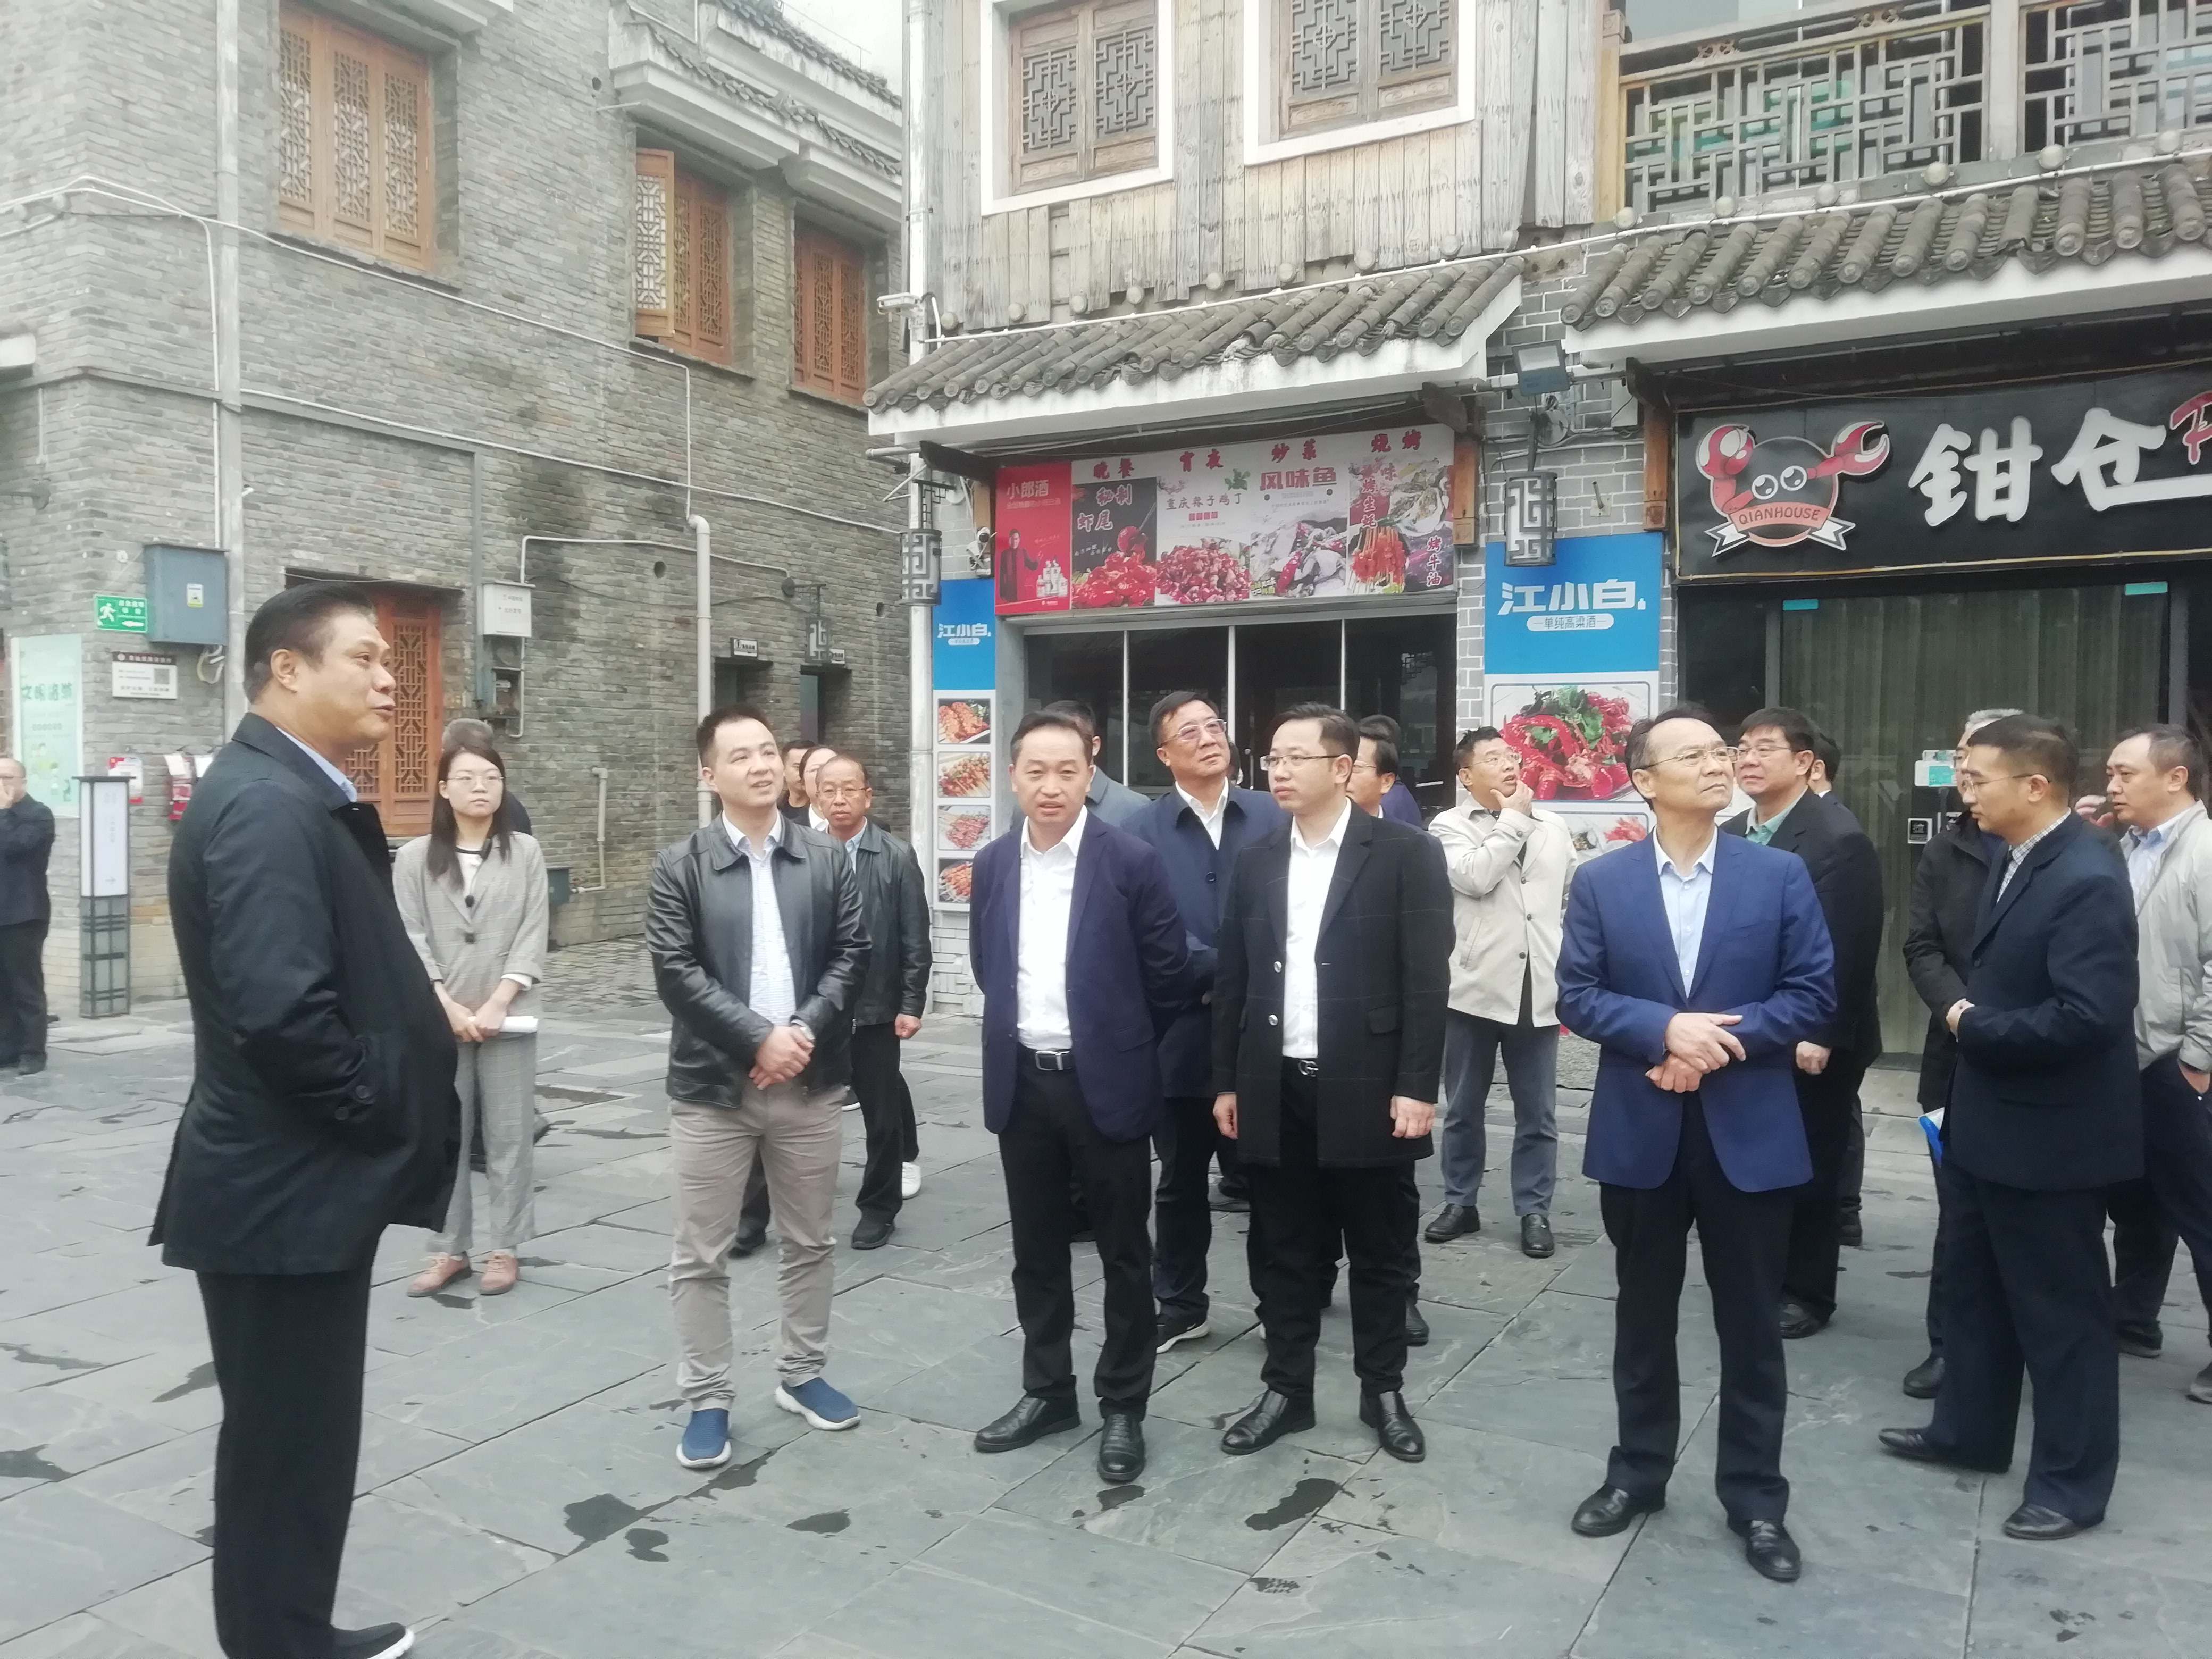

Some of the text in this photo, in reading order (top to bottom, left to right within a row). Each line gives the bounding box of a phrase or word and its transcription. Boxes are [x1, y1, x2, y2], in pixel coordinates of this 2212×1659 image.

[1271, 438, 1317, 463] 炒菜
[1371, 429, 1421, 453] 烧烤
[1007, 480, 1049, 500] 小郎酒
[1260, 467, 1337, 491] 风味鱼
[1096, 483, 1132, 506] 秘制
[1166, 493, 1242, 510] 重庆辣子鸡丁
[1077, 509, 1113, 532] 虾尾
[1739, 507, 1821, 525] QIANHOUSE
[1427, 535, 1442, 587] 烤牛油
[1497, 579, 1636, 615] 江小白
[937, 623, 987, 638] 江小白
